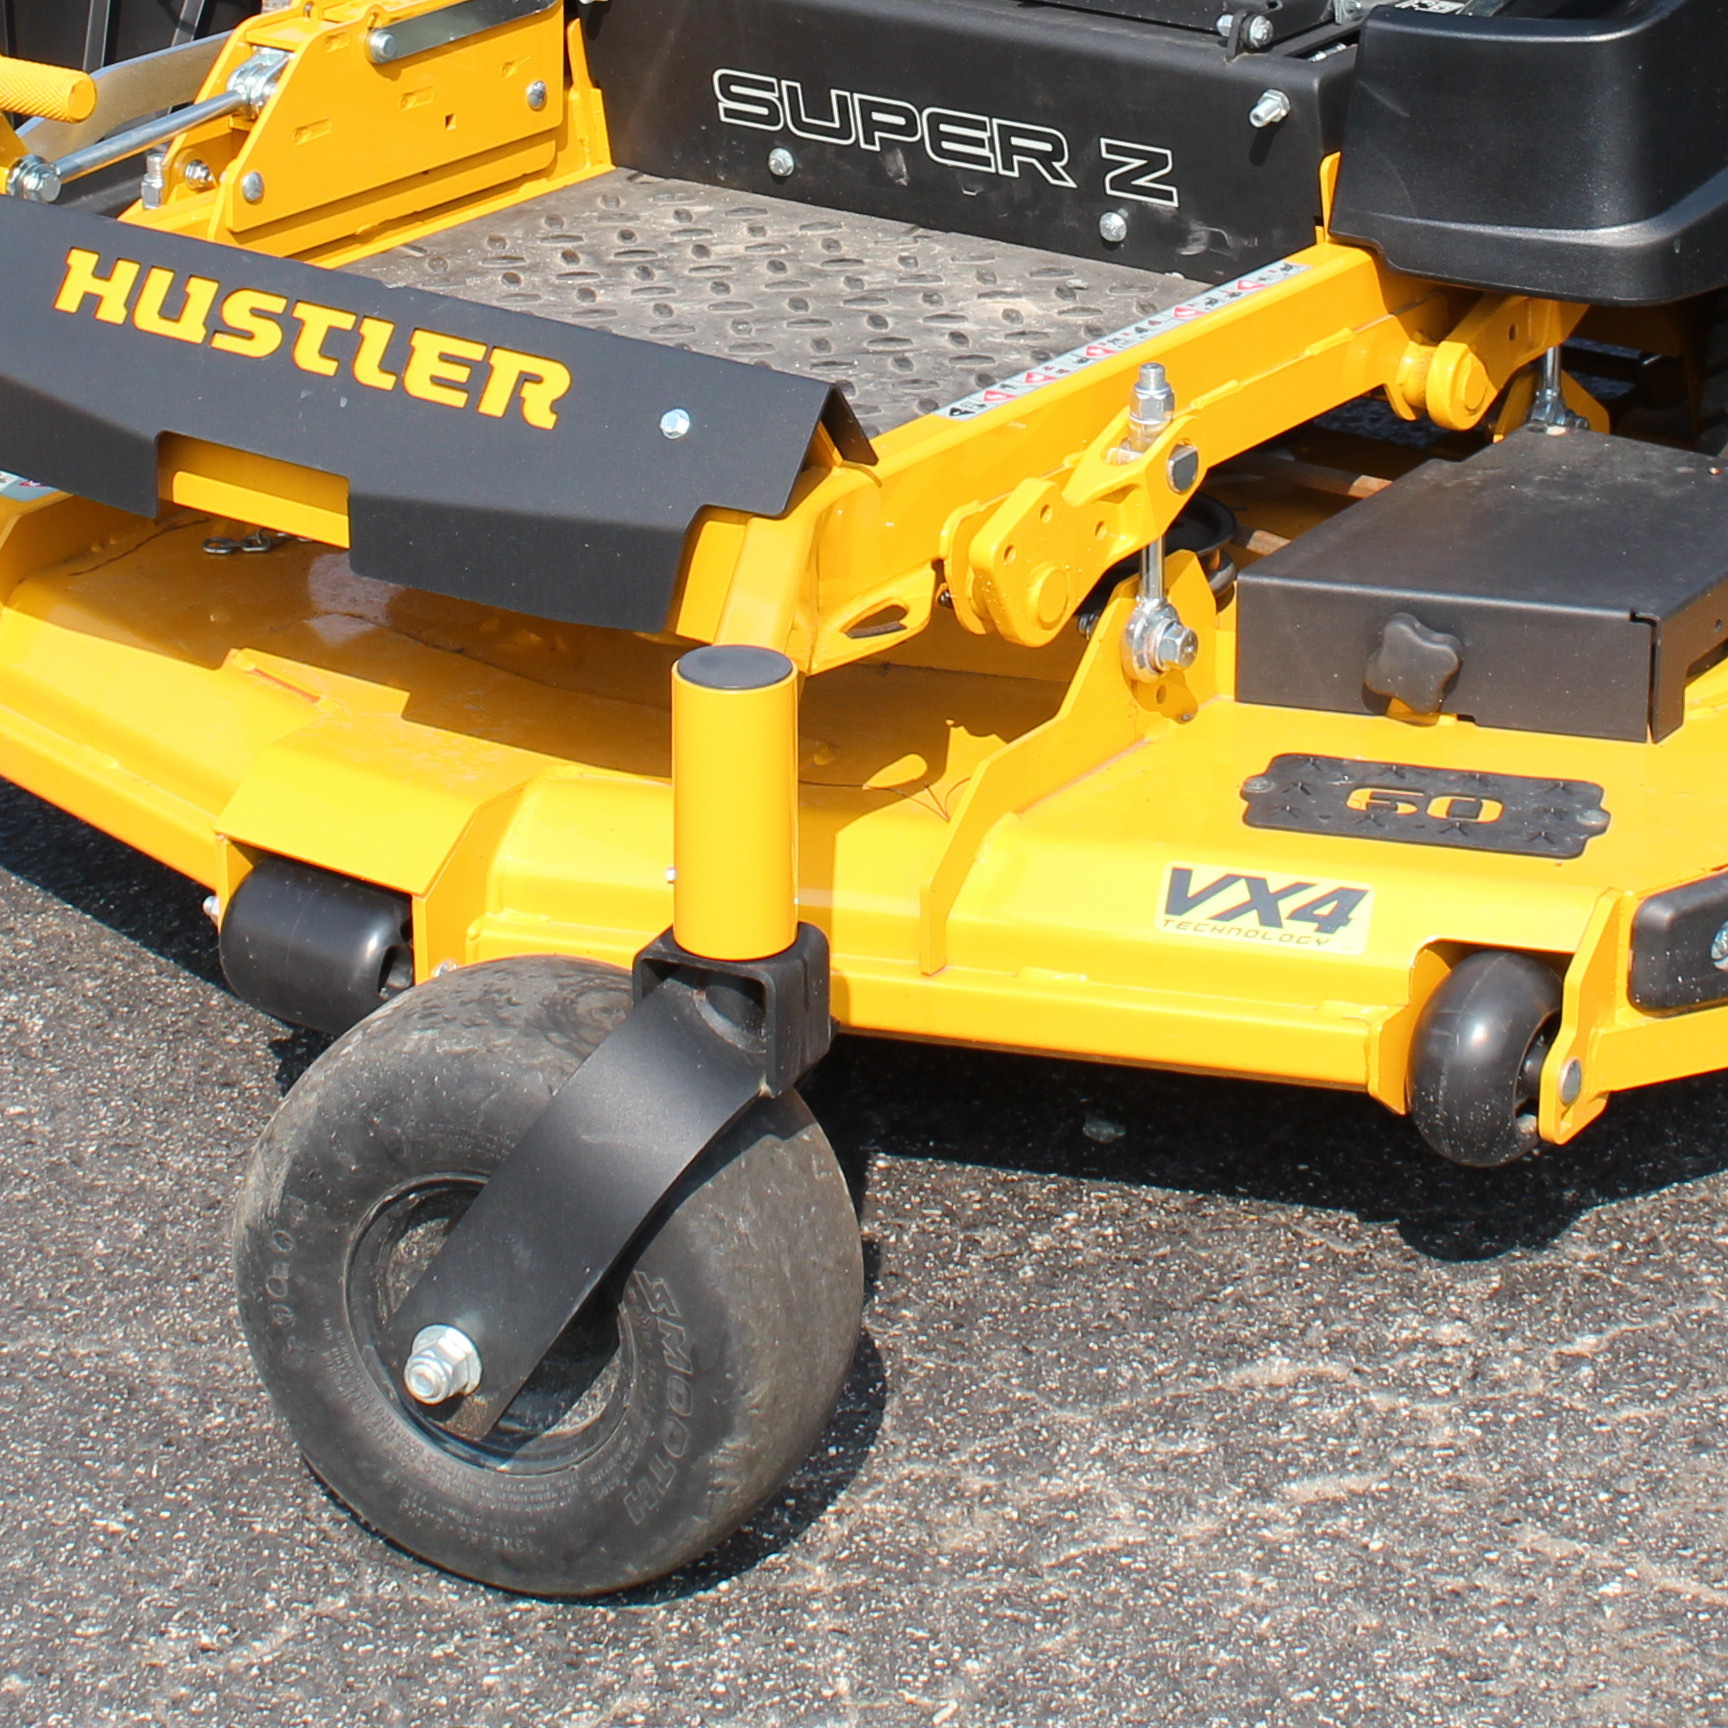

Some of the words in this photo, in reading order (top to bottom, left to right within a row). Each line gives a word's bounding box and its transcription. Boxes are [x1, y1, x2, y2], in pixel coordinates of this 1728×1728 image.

[712, 68, 1078, 189] SUPER
[1099, 137, 1180, 208] Z
[53, 246, 572, 431] HUSTLER
[1345, 787, 1505, 824] 60
[1161, 918, 1331, 946] TECHNOLOGY
[1164, 866, 1371, 935] VX4
